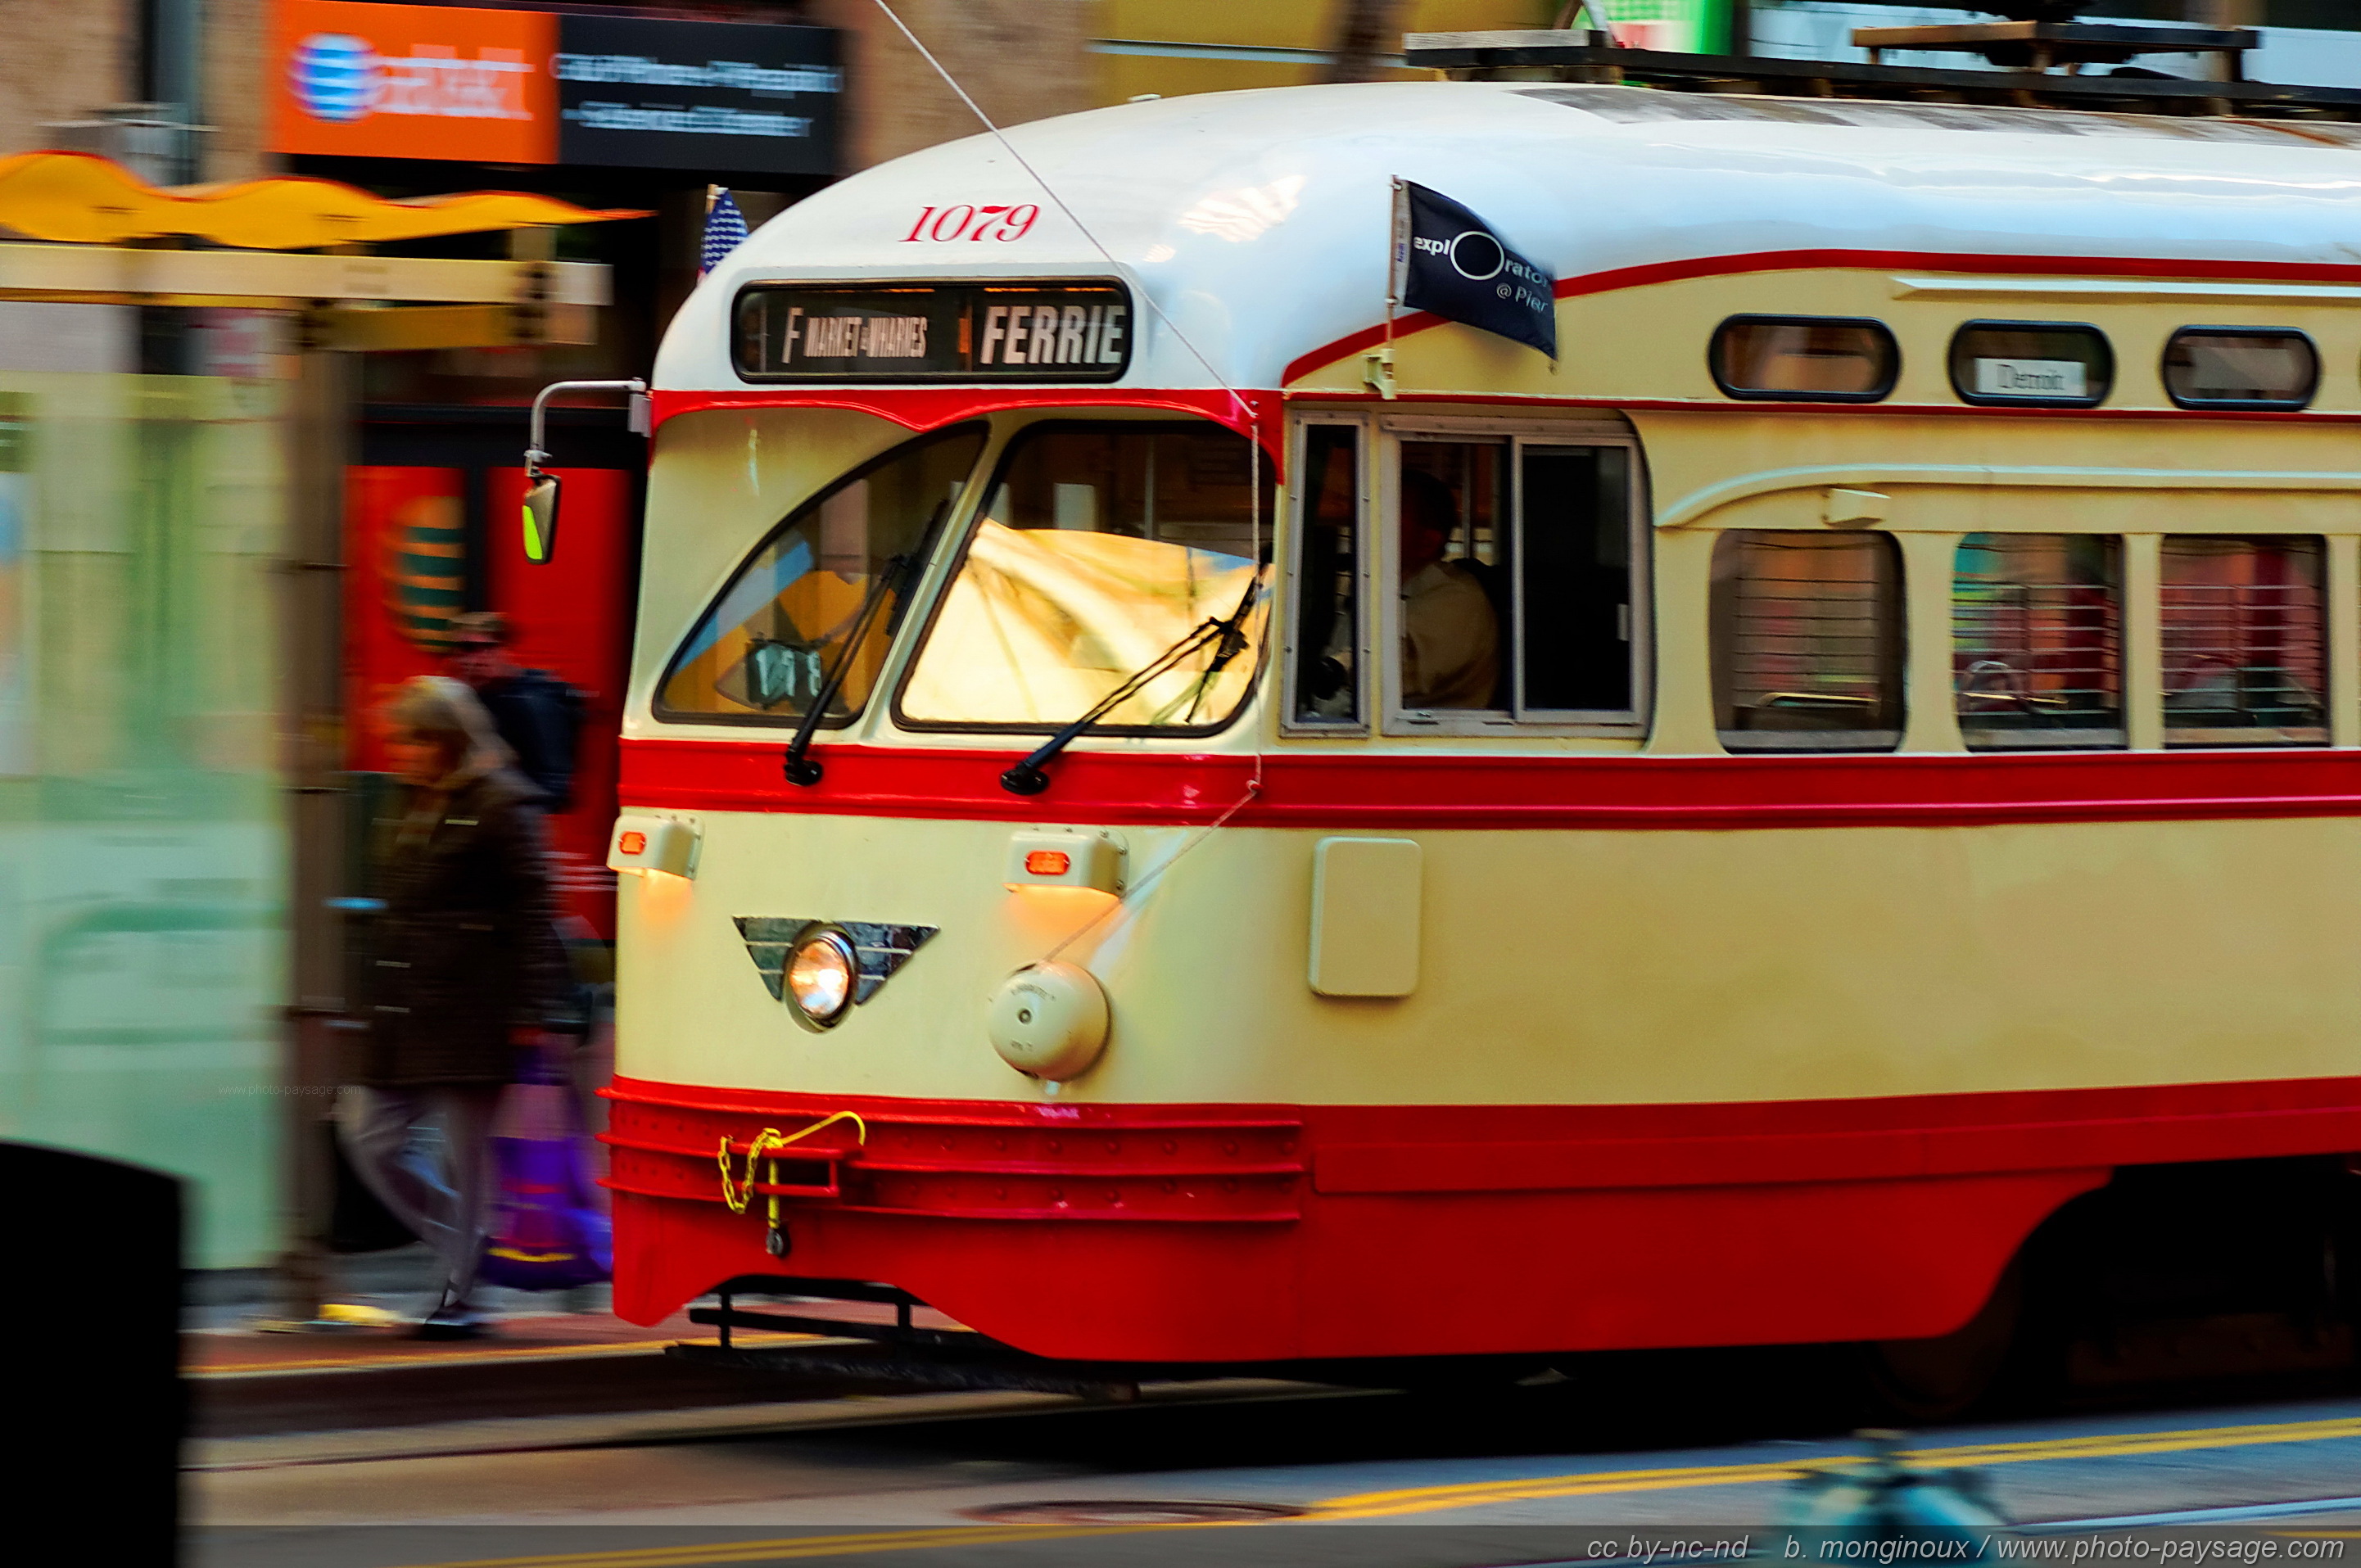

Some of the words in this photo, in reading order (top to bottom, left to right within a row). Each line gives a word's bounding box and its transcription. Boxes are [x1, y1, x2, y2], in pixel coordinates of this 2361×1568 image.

[898, 205, 1040, 242] 1079
[1514, 285, 1549, 313] Pier
[780, 306, 804, 364] F
[980, 305, 1127, 364] FERRIE
